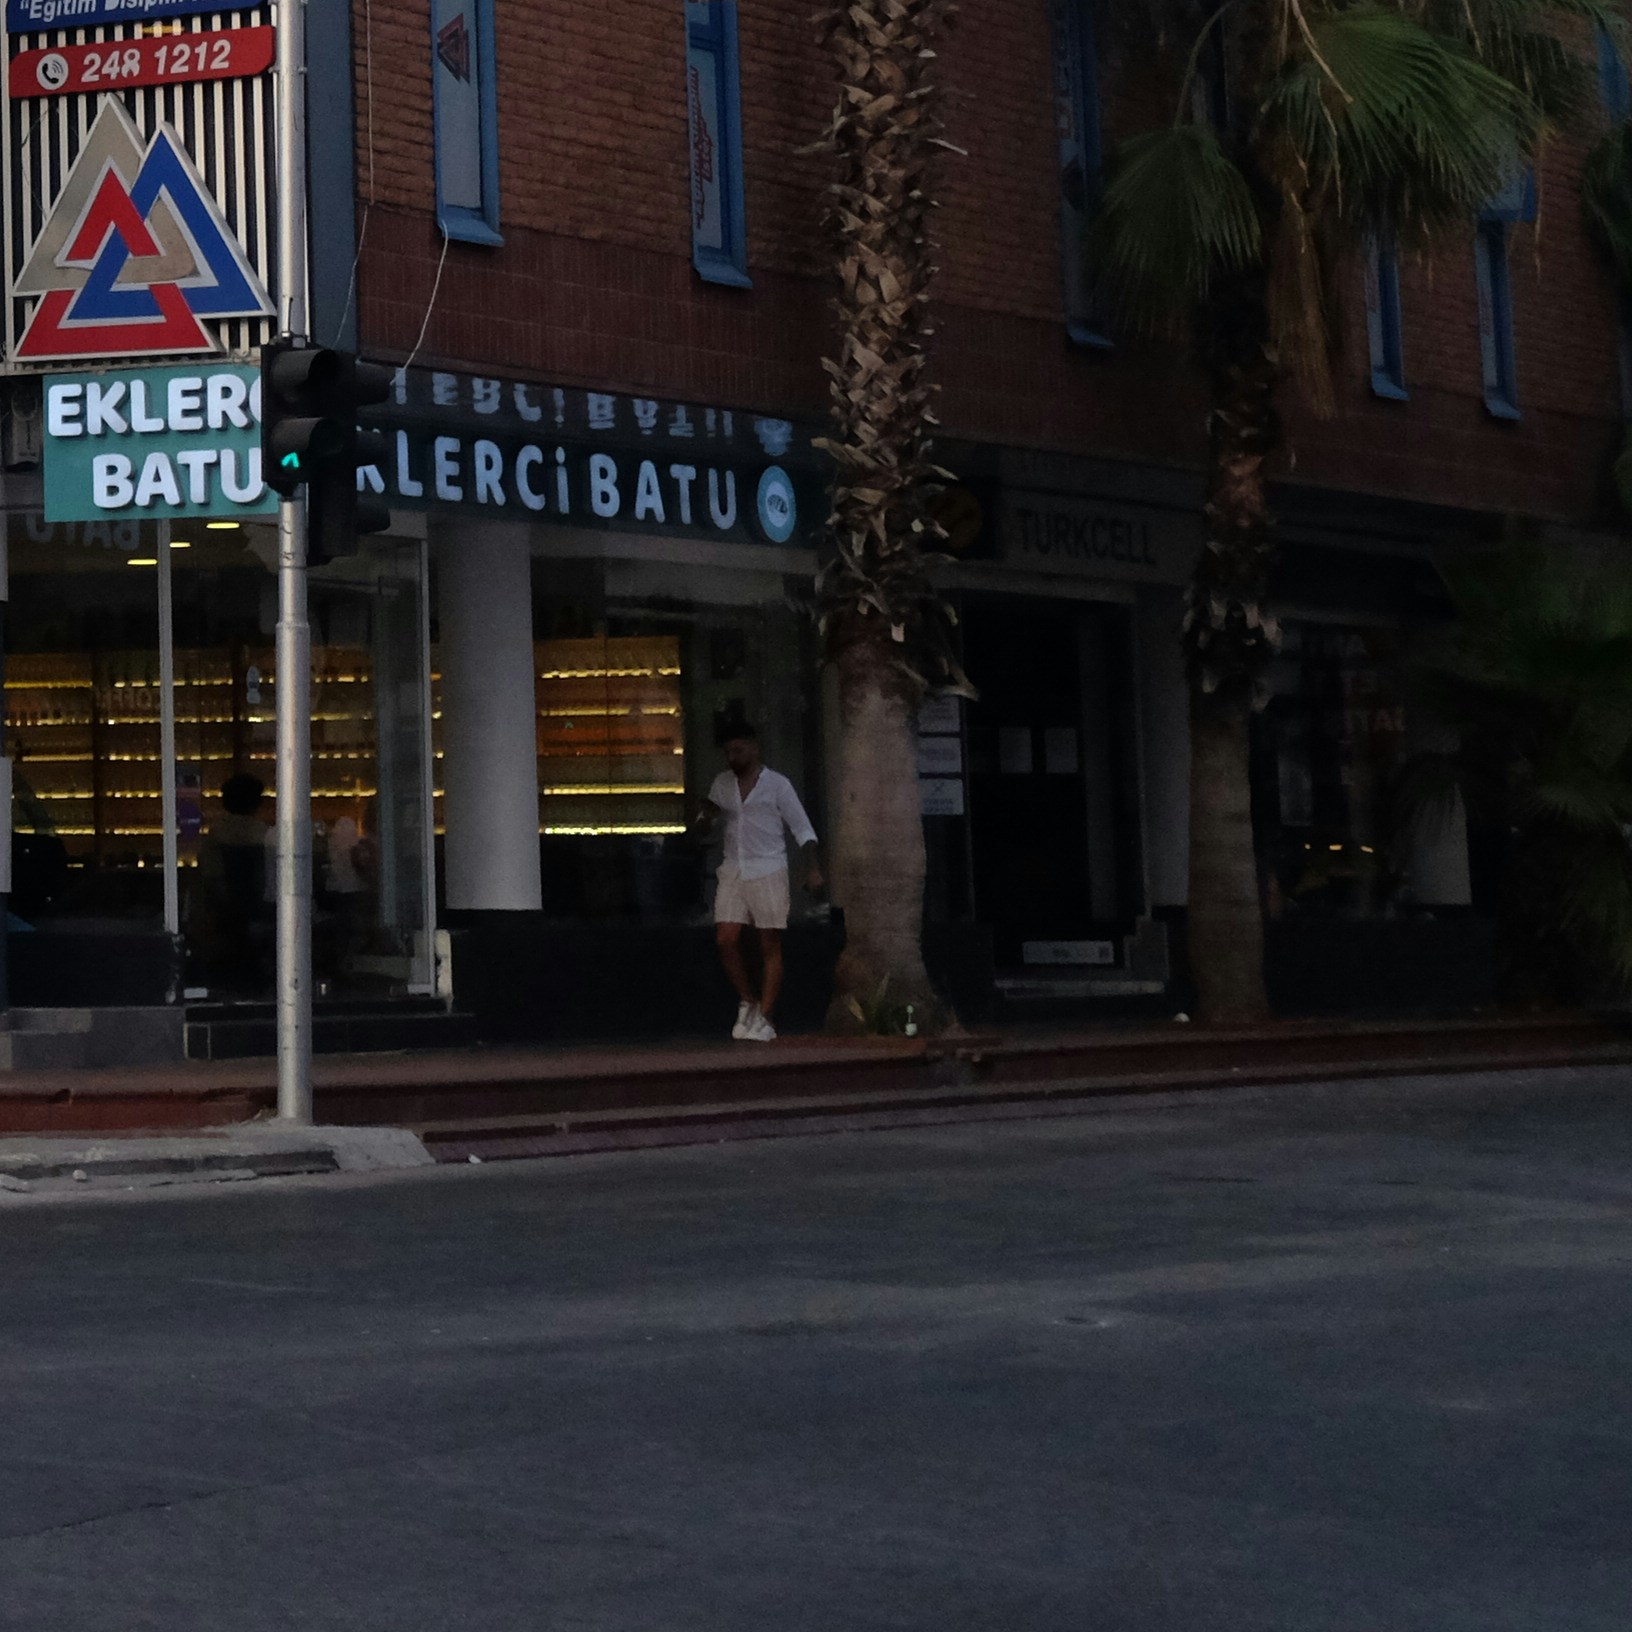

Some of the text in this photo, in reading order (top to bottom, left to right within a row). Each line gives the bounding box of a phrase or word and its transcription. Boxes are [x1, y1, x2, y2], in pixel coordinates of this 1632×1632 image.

[80, 38, 232, 84] 248 1212
[46, 372, 262, 439] EKLER
[91, 447, 265, 510] BATU
[588, 452, 738, 531] BATU
[1014, 507, 1157, 567] TURKCELL
